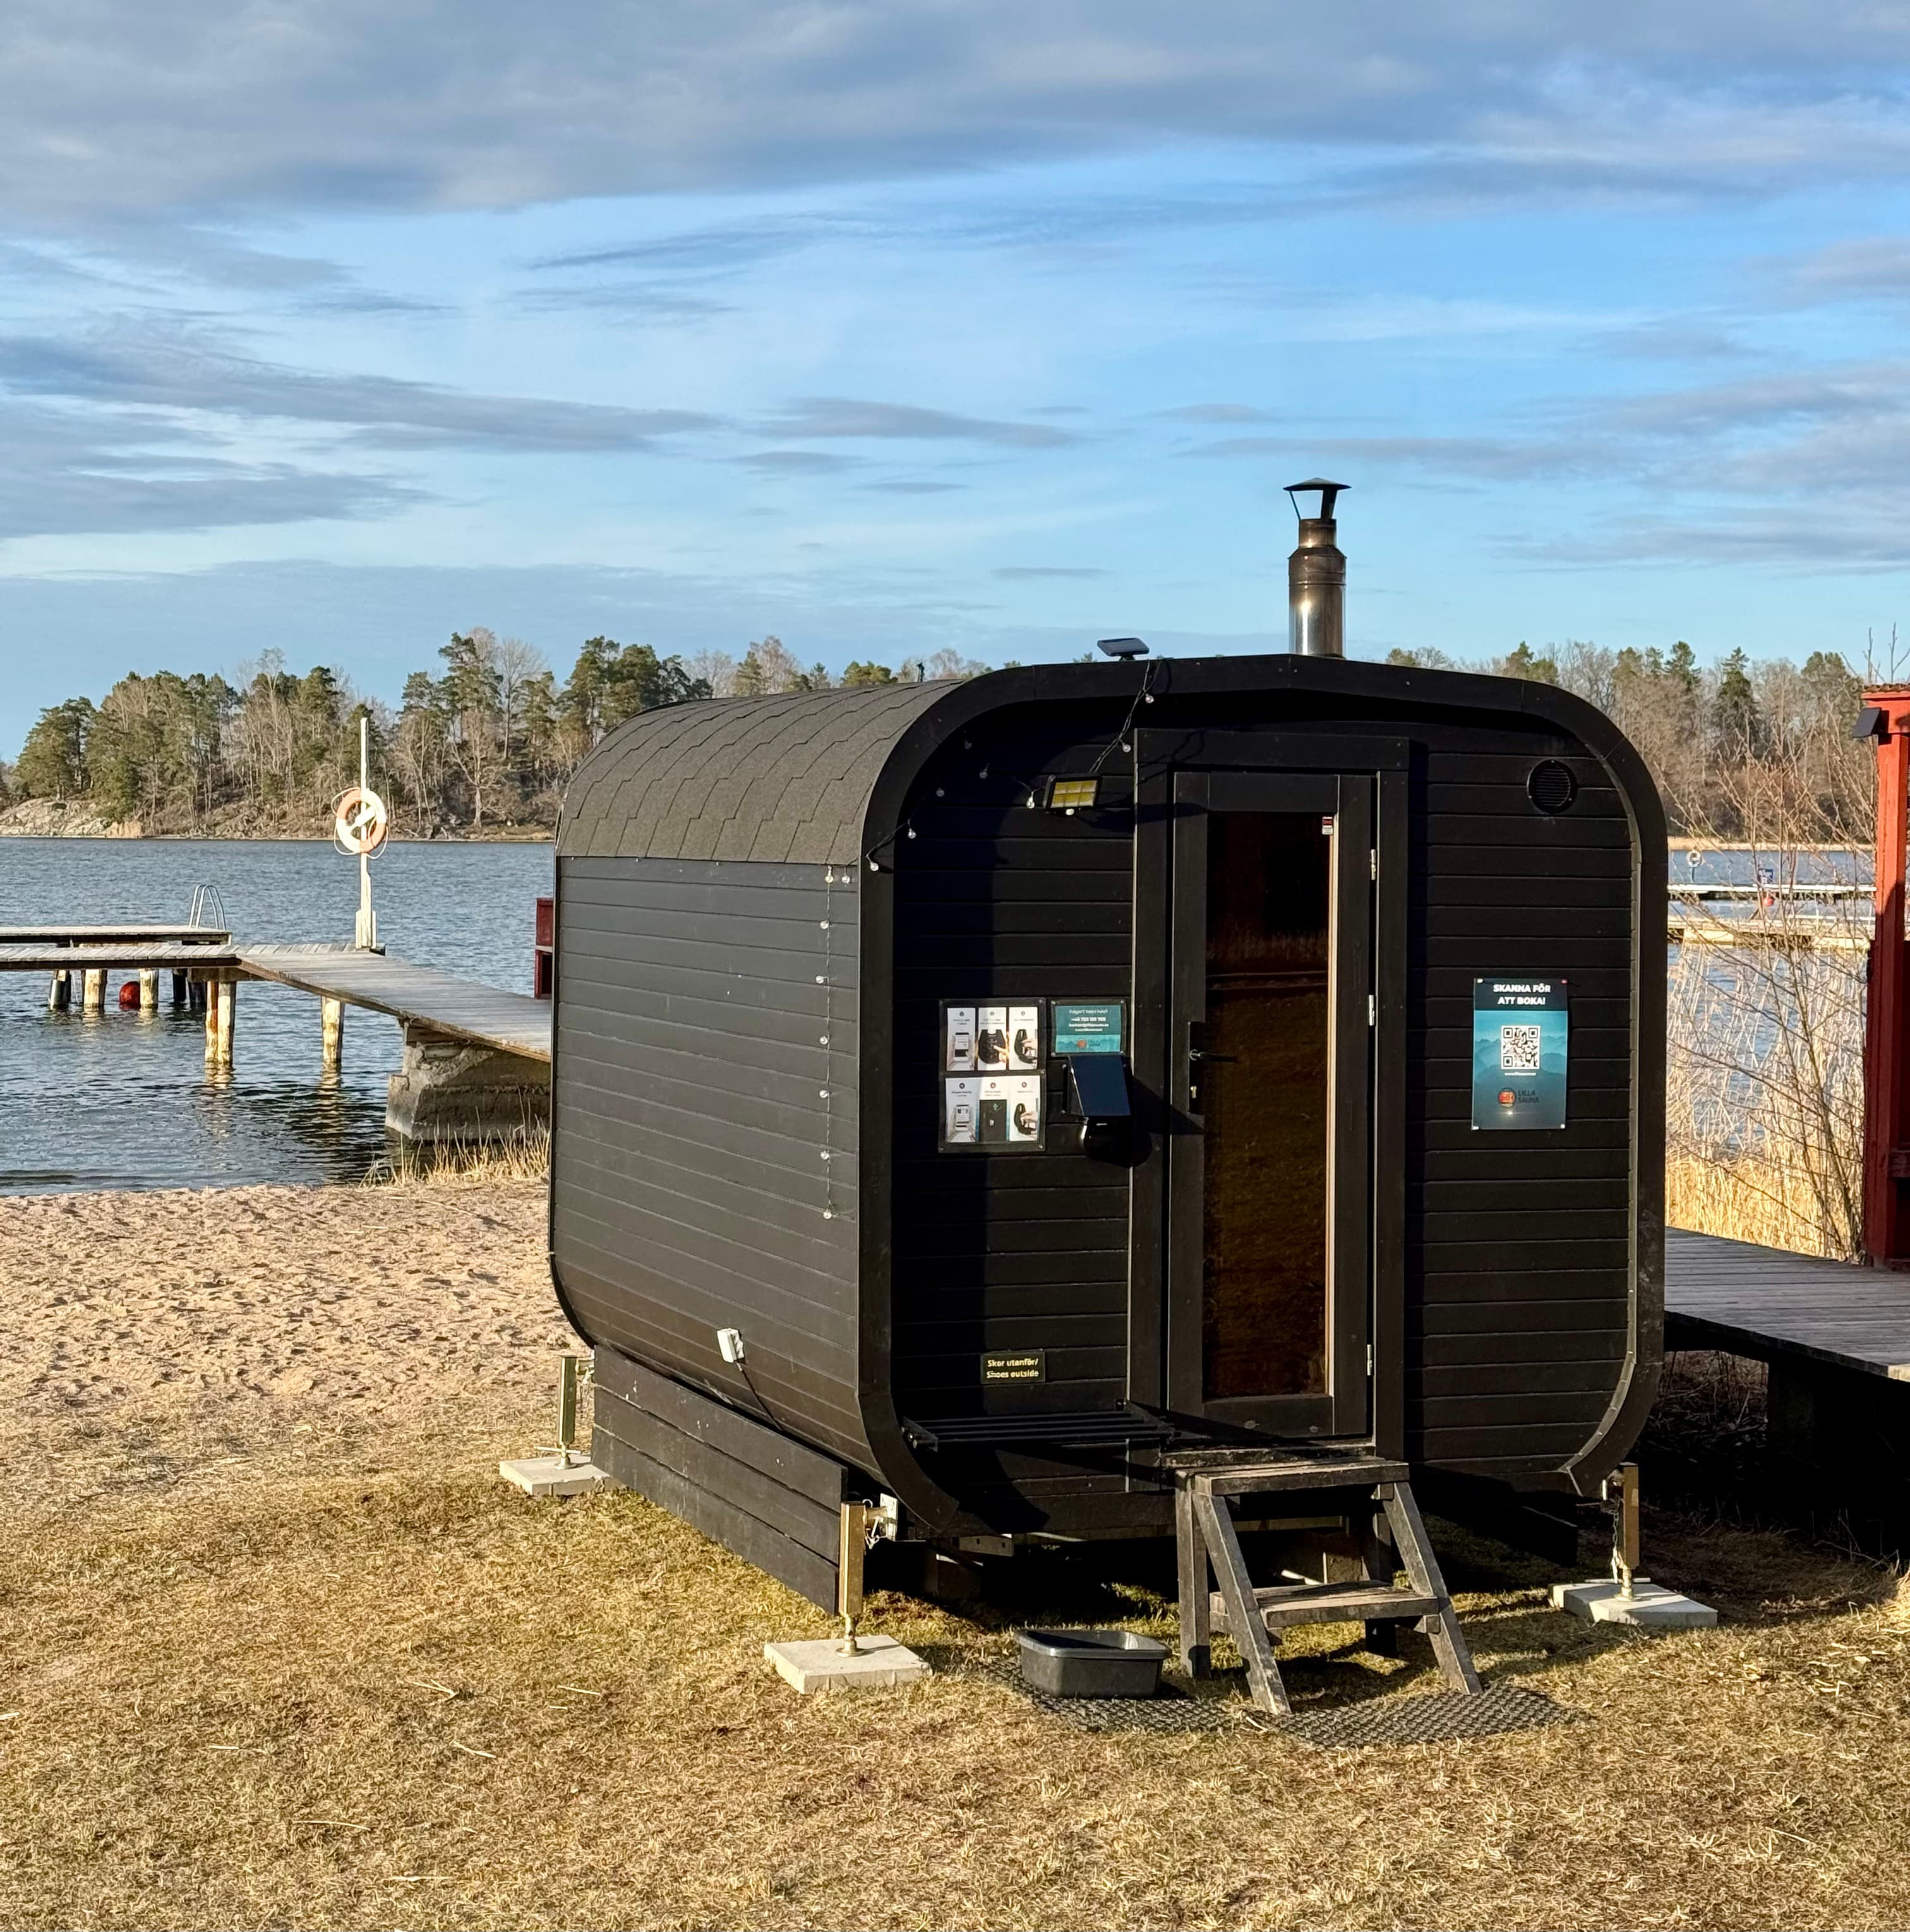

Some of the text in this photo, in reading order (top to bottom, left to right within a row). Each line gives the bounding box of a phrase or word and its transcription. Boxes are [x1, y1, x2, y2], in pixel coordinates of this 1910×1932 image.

[1493, 983, 1551, 993] SKANNA FÖR
[1498, 996, 1546, 1005] ATT BOKA!
[987, 1359, 1006, 1367] Skor
[1010, 1369, 1040, 1378] outside
